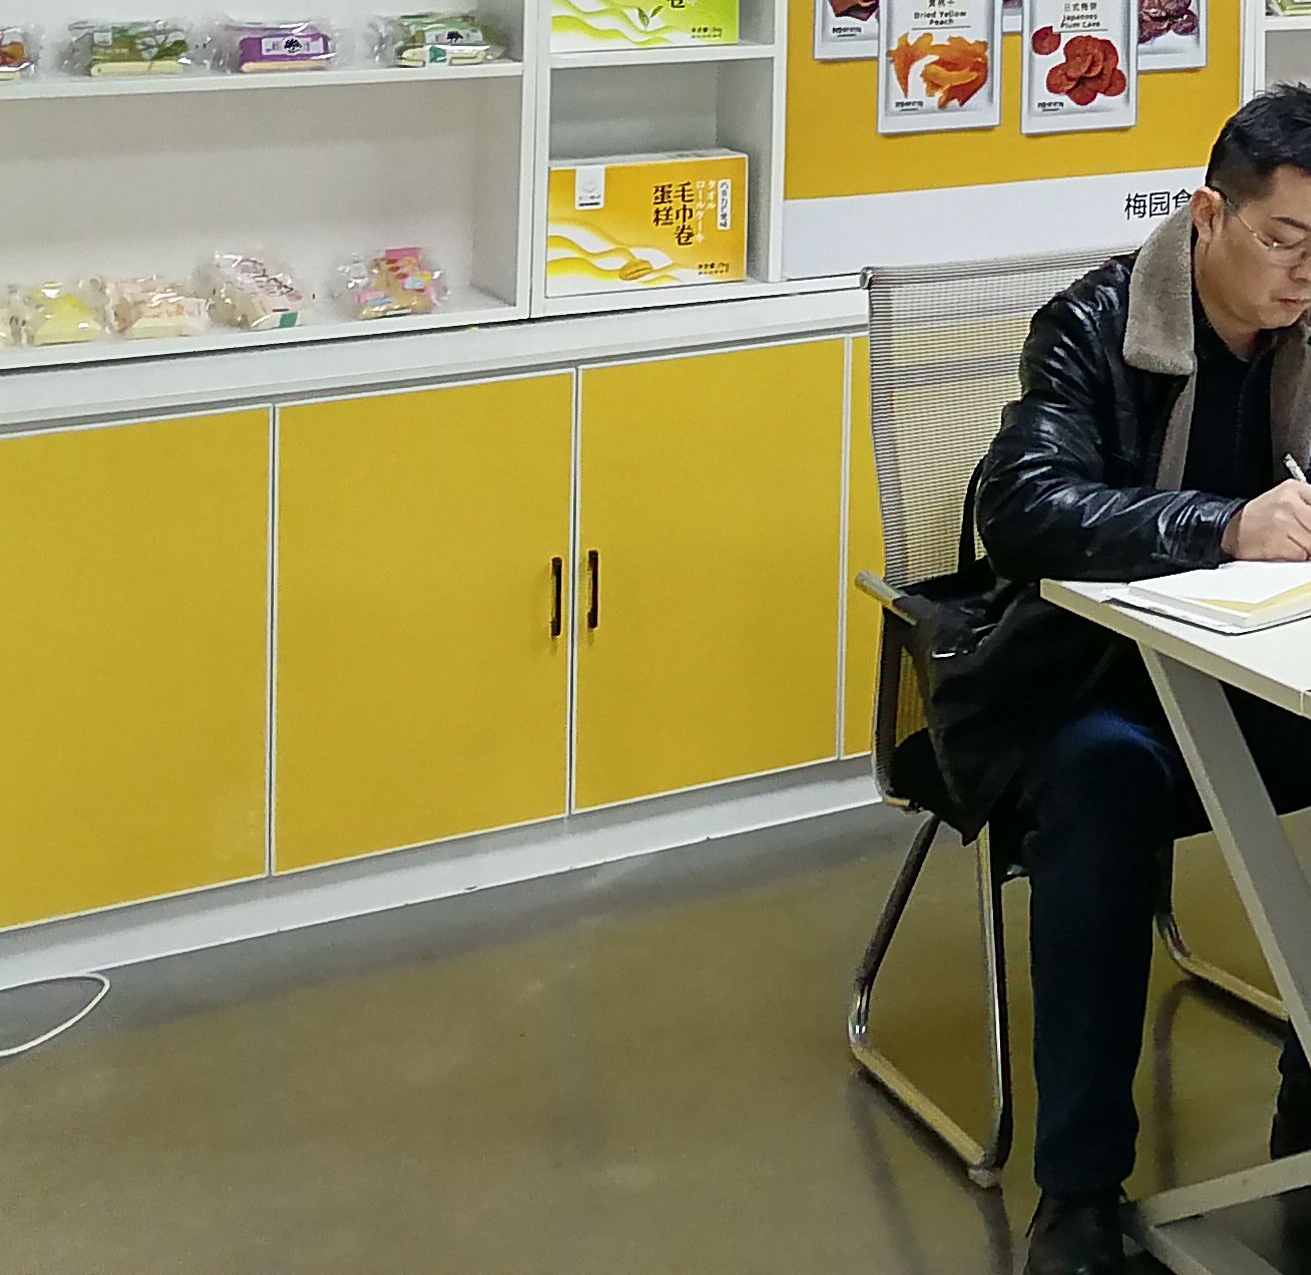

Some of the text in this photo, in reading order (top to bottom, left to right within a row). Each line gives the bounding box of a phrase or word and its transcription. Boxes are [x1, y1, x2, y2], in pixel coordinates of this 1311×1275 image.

[939, 9, 967, 18] Yellow
[652, 184, 674, 227] 蛋糕
[675, 181, 695, 246] 毛巾卷
